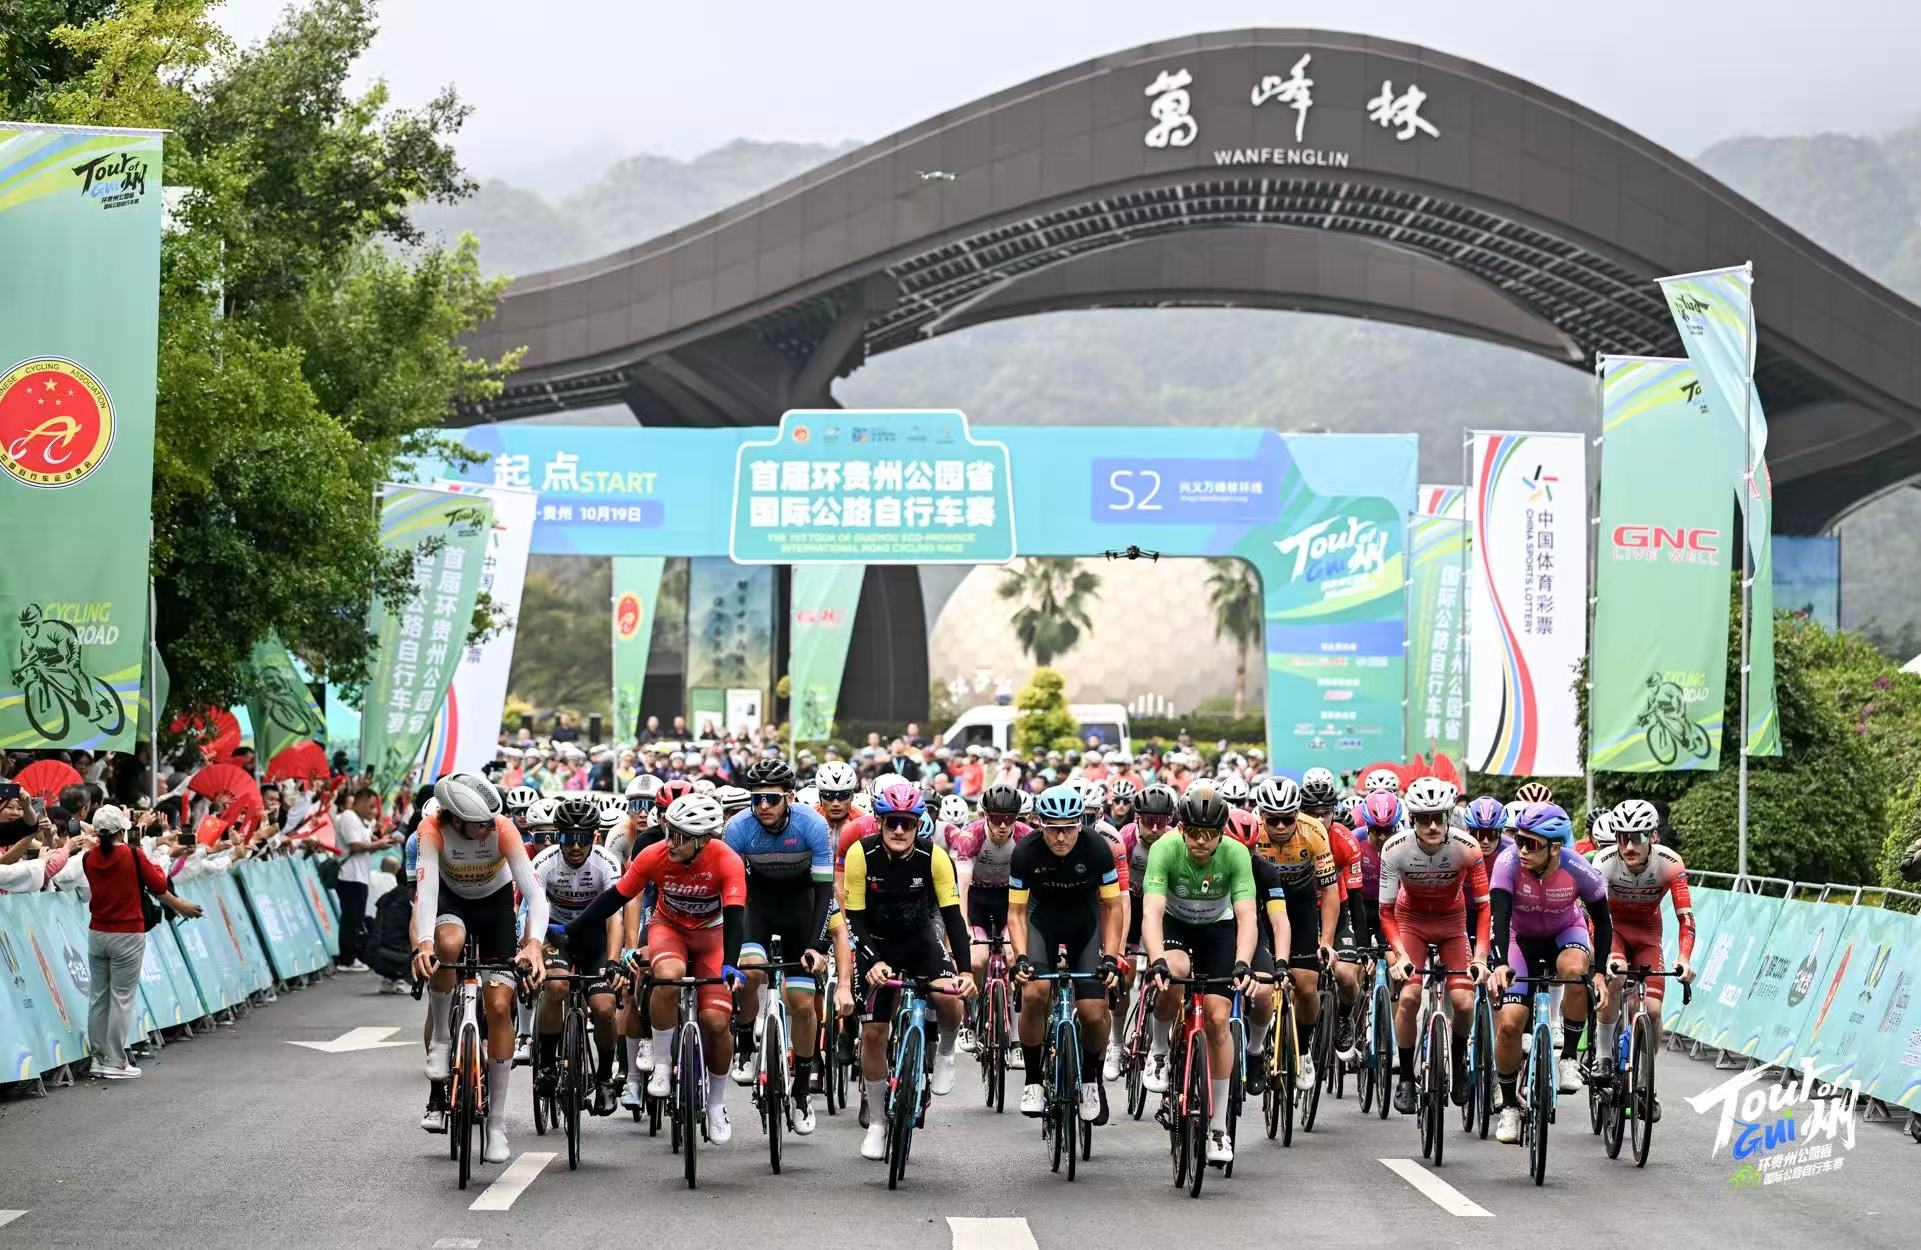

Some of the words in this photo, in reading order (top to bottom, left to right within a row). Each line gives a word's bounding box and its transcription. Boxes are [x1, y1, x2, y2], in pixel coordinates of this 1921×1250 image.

[72, 152, 140, 196] Tour
[1214, 148, 1349, 168] WANFENGLIN
[0, 374, 18, 397] INESE
[25, 363, 60, 374] CYCLING
[70, 369, 107, 409] ASSOCIATION
[1680, 380, 1702, 405] To
[494, 451, 580, 491] 起点
[580, 472, 657, 494] START
[750, 460, 995, 492] 首届环贵州公园省
[1108, 470, 1163, 511] S2
[534, 505, 573, 521] ·贵州
[580, 506, 641, 522] 10月19日
[750, 496, 996, 528] 国际公路自行车赛
[1525, 509, 1533, 541] CHINA
[1272, 515, 1376, 584] Tour
[1612, 524, 1720, 553] GNC
[1525, 543, 1533, 586] SPORTS
[1536, 509, 1555, 635] 中国体育彩票
[44, 602, 112, 624] CYCLING
[1525, 588, 1533, 635] LOTTERY
[75, 625, 120, 645] ROAD
[408, 547, 466, 734] 首届环贵州公园省
[1424, 565, 1461, 739] 国际公路自行车赛
[1453, 835, 1476, 848] GIANT
